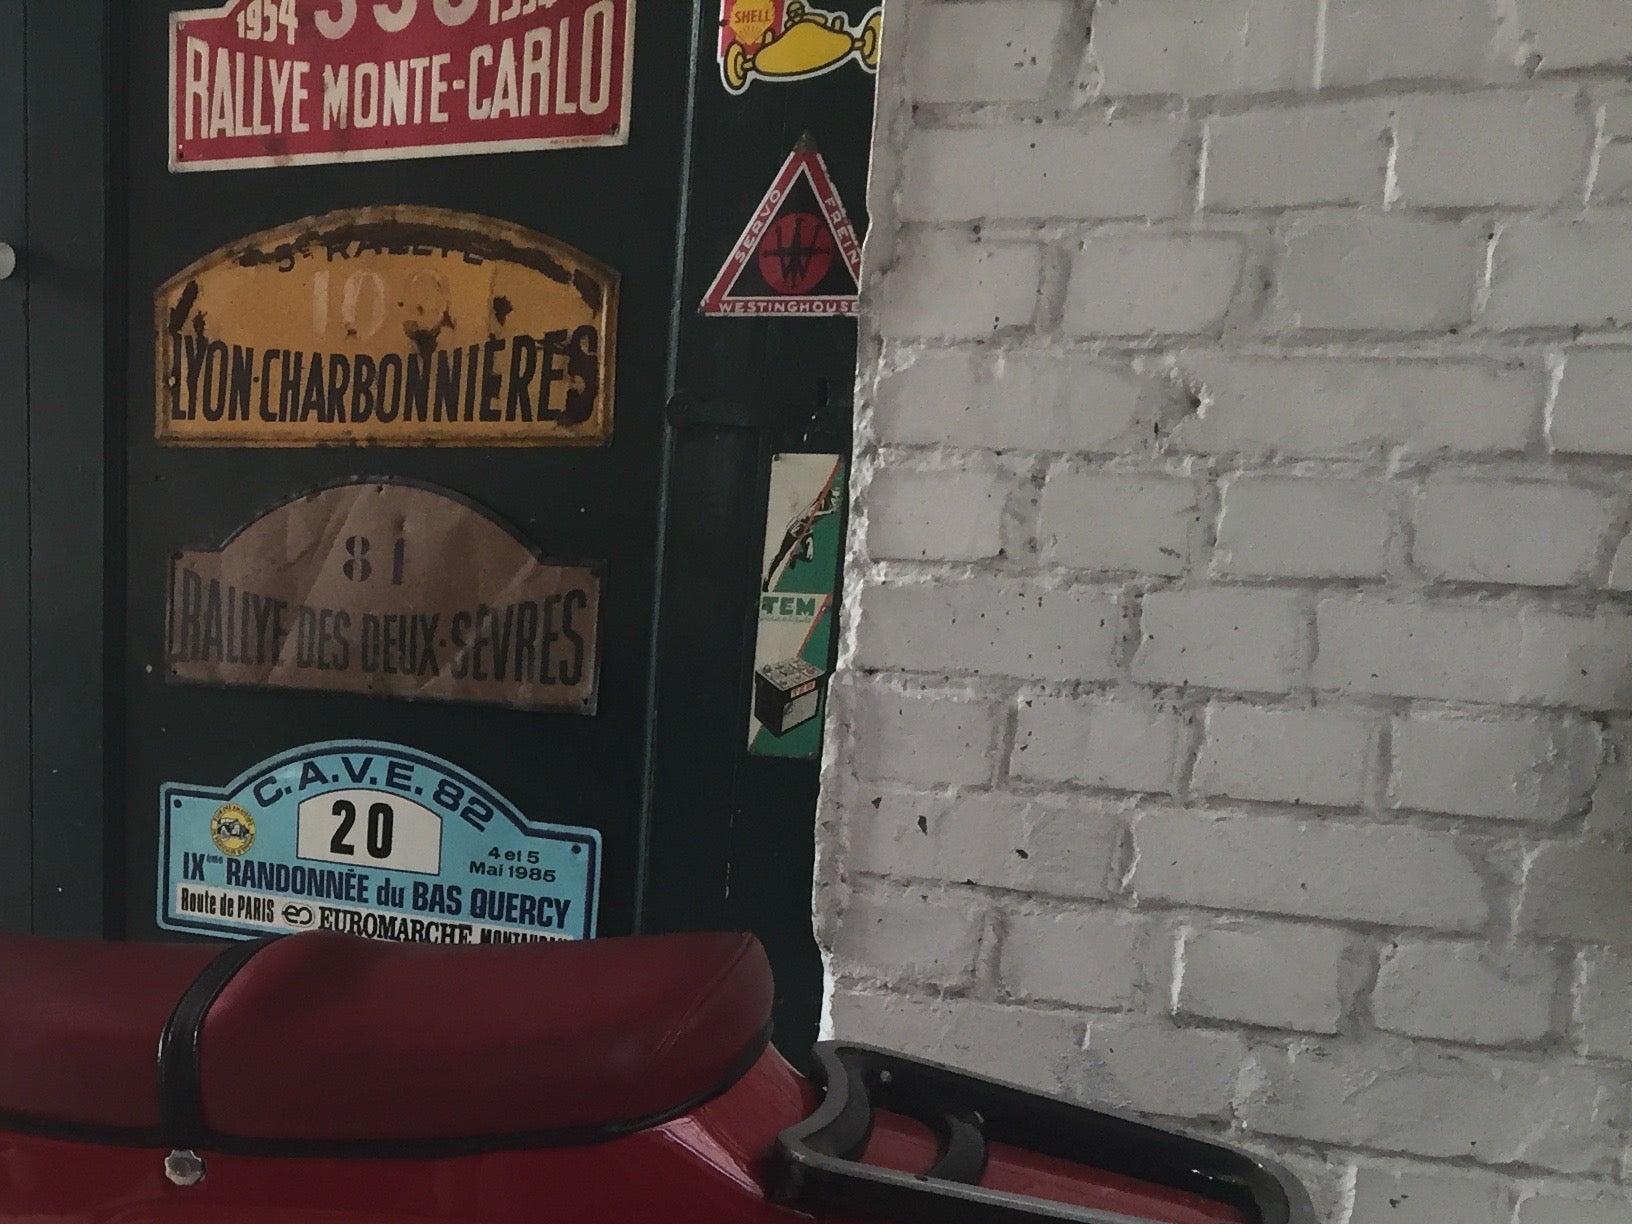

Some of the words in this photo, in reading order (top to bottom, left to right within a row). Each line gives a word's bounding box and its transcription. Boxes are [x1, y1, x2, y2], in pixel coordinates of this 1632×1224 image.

[734, 9, 770, 24] SHELL
[184, 36, 310, 140] RALLYE
[322, 0, 612, 131] MONTE-CARLO
[734, 189, 781, 264] SERVO
[824, 197, 861, 265] FREIN
[718, 300, 860, 313] WESTINGHOUSE
[180, 567, 288, 666] RALLYE
[296, 605, 351, 671] DES
[762, 596, 816, 616] TEM
[330, 799, 394, 859] 20
[488, 847, 501, 860] 4
[504, 850, 522, 863] et
[527, 851, 540, 864] 5
[226, 857, 370, 904] RANDONNÉE
[376, 877, 405, 909] du
[412, 881, 462, 916] BAS
[470, 887, 572, 929] QUERCY
[469, 861, 504, 877] Mai
[508, 865, 556, 883] 1985
[181, 888, 216, 915] Route
[220, 893, 234, 919] de
[237, 895, 275, 923] PARIS
[318, 906, 473, 945] EUROMARCHE
